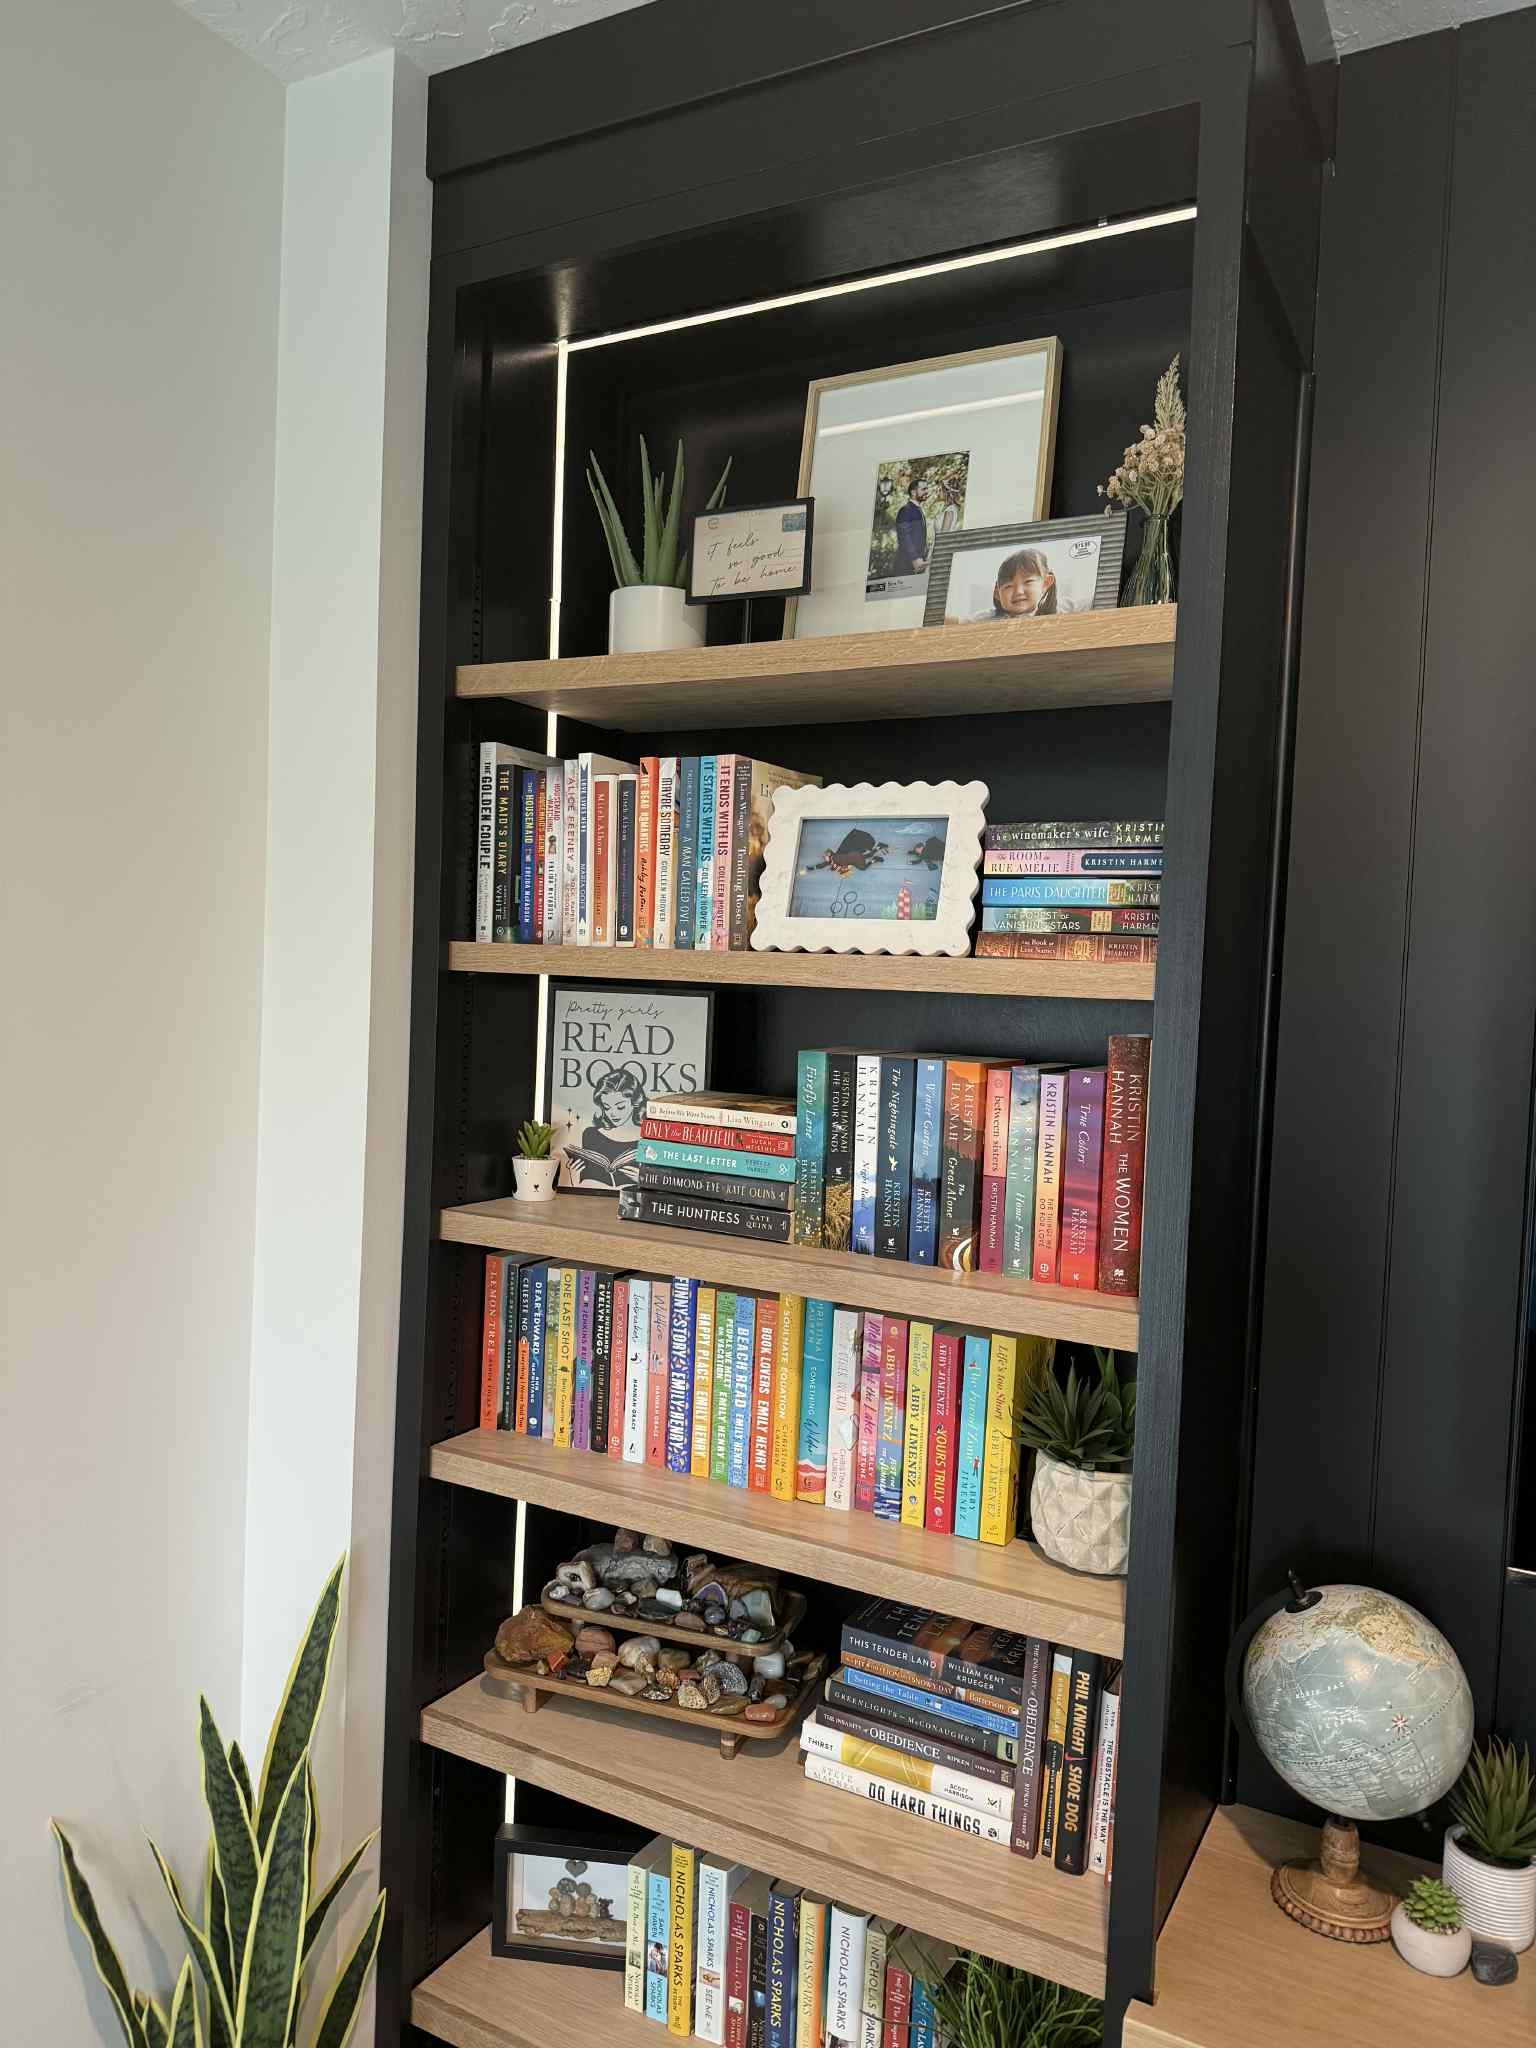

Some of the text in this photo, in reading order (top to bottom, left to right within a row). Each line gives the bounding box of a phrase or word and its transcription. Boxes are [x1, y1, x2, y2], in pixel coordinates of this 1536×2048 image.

[734, 571, 751, 584] be
[760, 566, 797, 578] home
[751, 543, 783, 568] good
[481, 777, 492, 821] GOLDEN
[498, 770, 508, 874] THE MAID'S DIARY
[525, 794, 533, 843] HOUSEMAID
[567, 778, 575, 860] ALICE FEENEY
[660, 778, 672, 855] MAYBE SOMEDAY
[701, 762, 714, 861] IT STARTS WITH US
[718, 766, 730, 855] IT ENDS WITH US
[480, 825, 491, 868] COUPLE
[638, 858, 647, 882] Ashley
[992, 864, 1015, 872] RUE
[1009, 852, 1042, 860] ROOM
[734, 847, 746, 924] Tending Roses
[561, 1022, 674, 1055] READ
[614, 1004, 664, 1020] girls
[560, 1058, 697, 1094] BOOKS
[802, 1065, 816, 1139] Firefly Lane
[856, 1067, 866, 1142] HANNAH
[868, 1066, 878, 1144] KRISTIN
[841, 1111, 849, 1152] HANNAH
[889, 1068, 900, 1149] The Nightingale
[949, 1083, 960, 1141] HANNAH
[963, 1084, 975, 1142] KRISTIN
[992, 1096, 1004, 1172] between sisters
[1044, 1082, 1057, 1184] KRISTIN HANNAH
[1078, 1103, 1090, 1164] True Colors
[1109, 1071, 1125, 1144] HANNAH
[1127, 1074, 1141, 1142] KRISTIN
[645, 1173, 658, 1183] THE
[663, 1176, 703, 1189] DIAMOND
[706, 1183, 719, 1192] EYE
[749, 1188, 775, 1200] QUINN
[664, 1151, 736, 1168] THE LAST LETTER
[946, 1157, 957, 1218] Great Alone
[652, 1202, 740, 1224] THE HUNTRESS
[884, 1180, 892, 1226] HANNAH
[892, 1182, 900, 1226] KRISTIN
[923, 1190, 931, 1232] KRISTIN
[989, 1182, 998, 1249] KRISTIN HANNAH
[1013, 1193, 1026, 1251] Home Front
[1112, 1153, 1131, 1251] THE WOMEN
[522, 1318, 528, 1331] NG
[533, 1312, 541, 1354] EDWARD
[561, 1274, 572, 1360] ONE LAST SHOT
[669, 1277, 689, 1450] FUNNY STORY EMILY HENRY
[695, 1313, 711, 1458] HAPPY PLACE EMILY HENRY
[735, 1328, 749, 1407] BEACH READ
[779, 1311, 791, 1419] SOULMATE EQUATION
[882, 1345, 895, 1441] ABBY JIMENEZ
[936, 1344, 947, 1416] ABBY JIMENEZ
[717, 1392, 727, 1458] EMILY HENRY
[755, 1328, 772, 1470] BOOK LOVERS EMILY HENRY
[733, 1414, 744, 1469] EMILY HENRY
[907, 1385, 920, 1488] ABBY JIMENEZ
[934, 1429, 947, 1503] YOURS TRULY
[850, 1636, 936, 1669] THIS TENDER LAND
[948, 1663, 1004, 1684] WILLIAM KENT
[957, 1675, 994, 1690] KRUEGER
[1072, 1671, 1090, 1754] PHIL KNIGHT
[808, 1736, 834, 1751] THIRST
[1106, 1740, 1114, 1755] THE
[1064, 1765, 1082, 1832] SHOE DOG
[1102, 1757, 1112, 1797] OBSTACLE
[869, 1782, 980, 1835] DO HARD THINGS
[1099, 1825, 1108, 1843] WAY
[1101, 1809, 1109, 1823] THE
[673, 1871, 686, 1986] NICHOLAS SPARKS
[705, 1887, 715, 2021] NICHOLAS SPARKS SEE ME
[770, 1900, 784, 2028] NICHOLAS SPARKS
[803, 1913, 816, 2016] NICHOLAS SPARKS
[836, 1926, 850, 2030] NICHOLAS SPARKS
